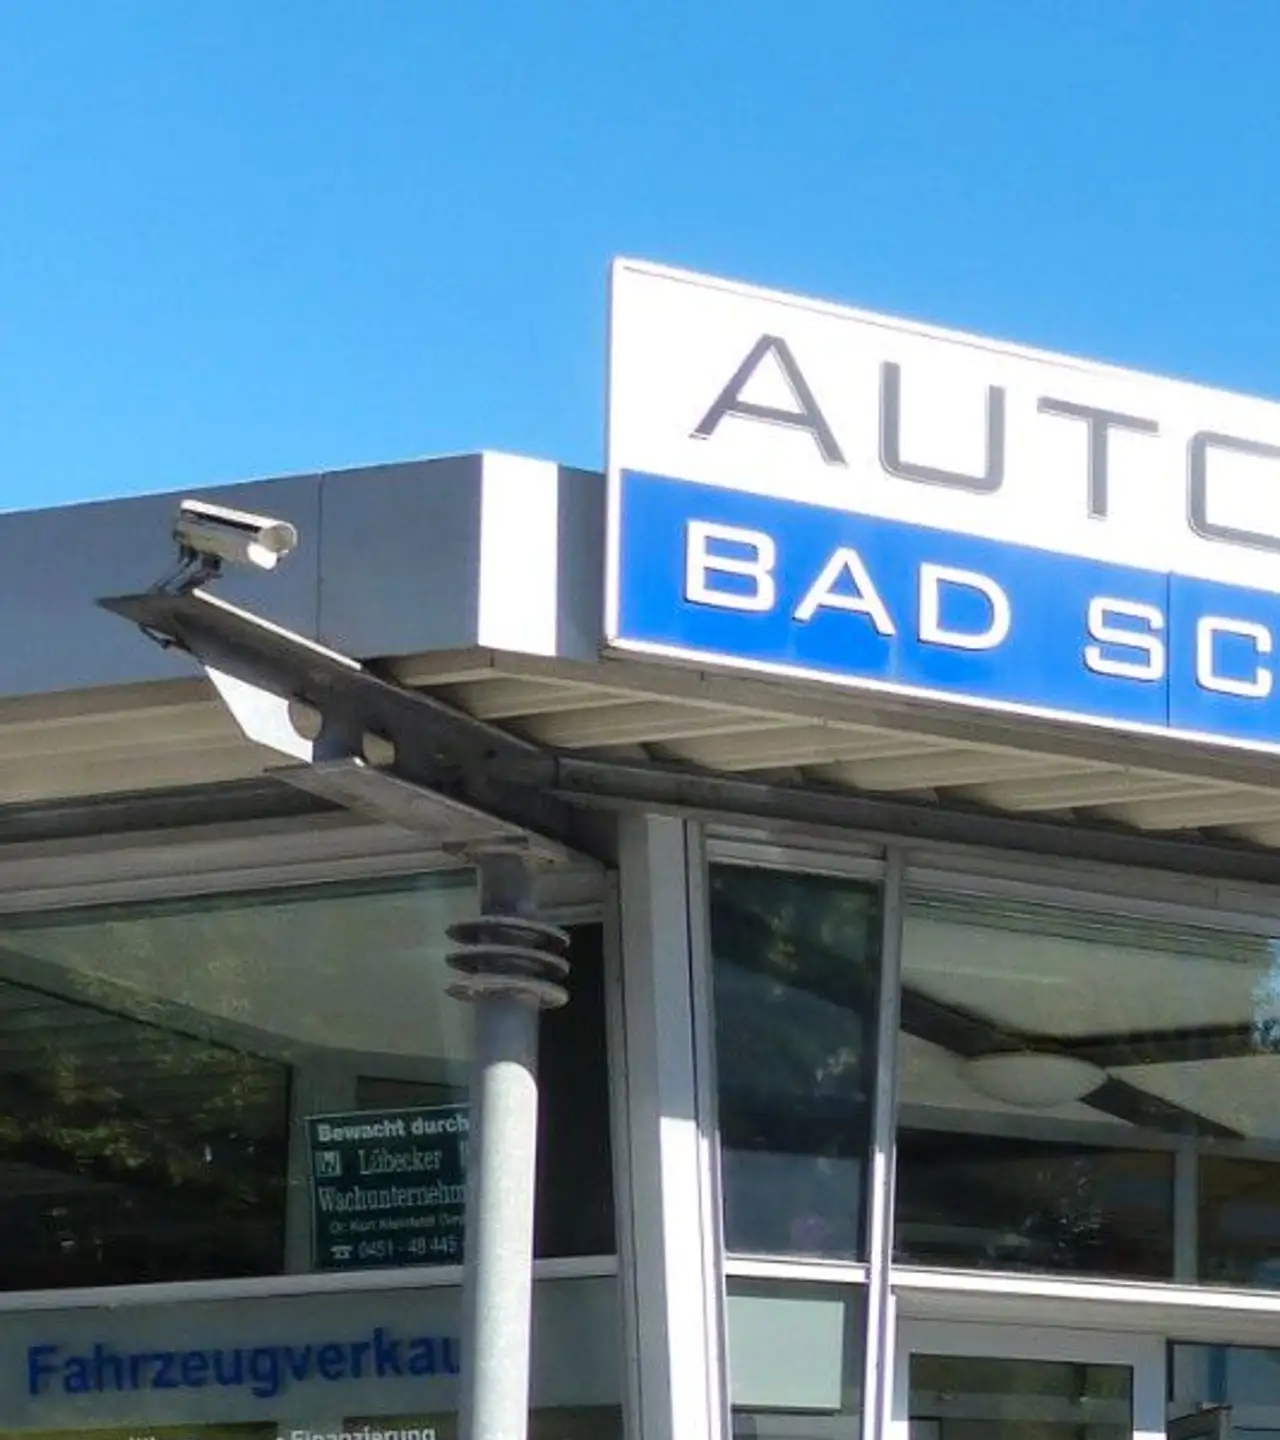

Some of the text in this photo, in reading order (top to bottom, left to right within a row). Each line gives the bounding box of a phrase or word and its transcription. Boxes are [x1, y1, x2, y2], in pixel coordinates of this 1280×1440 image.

[684, 521, 1011, 653] BAD
[317, 1114, 469, 1141] Bewacht durch
[358, 1146, 442, 1174] Lübecker
[318, 1181, 466, 1211] Wachunternehm
[28, 1327, 460, 1397] Fahrzeugverkau
